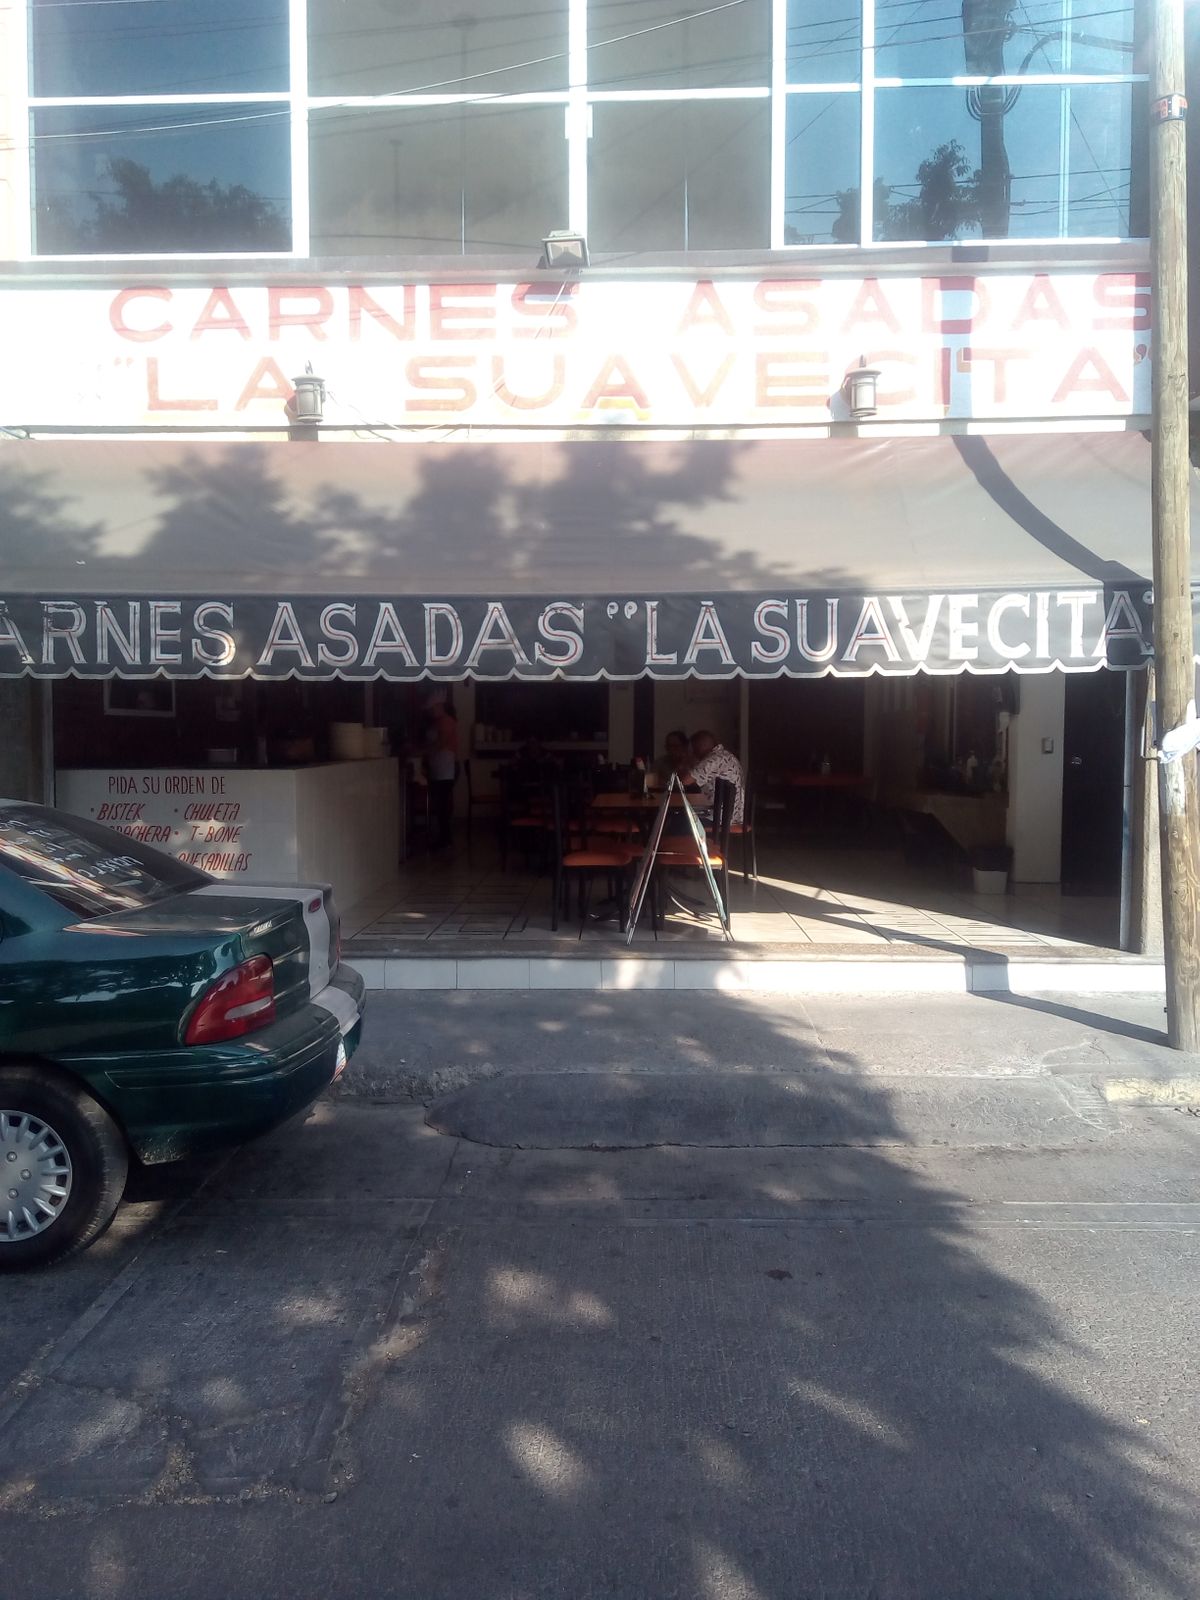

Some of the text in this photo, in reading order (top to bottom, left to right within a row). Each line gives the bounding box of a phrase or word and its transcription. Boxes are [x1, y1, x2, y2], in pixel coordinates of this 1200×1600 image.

[108, 272, 1152, 343] CARNES ASADAS
[256, 601, 586, 668] ASADAS
[108, 776, 226, 795] PIDA SU ORDEN DE
[96, 802, 146, 821] BISTEK
[183, 802, 241, 821] CHULETA
[110, 825, 172, 843] ACHERA
[191, 825, 244, 843] T-BONE
